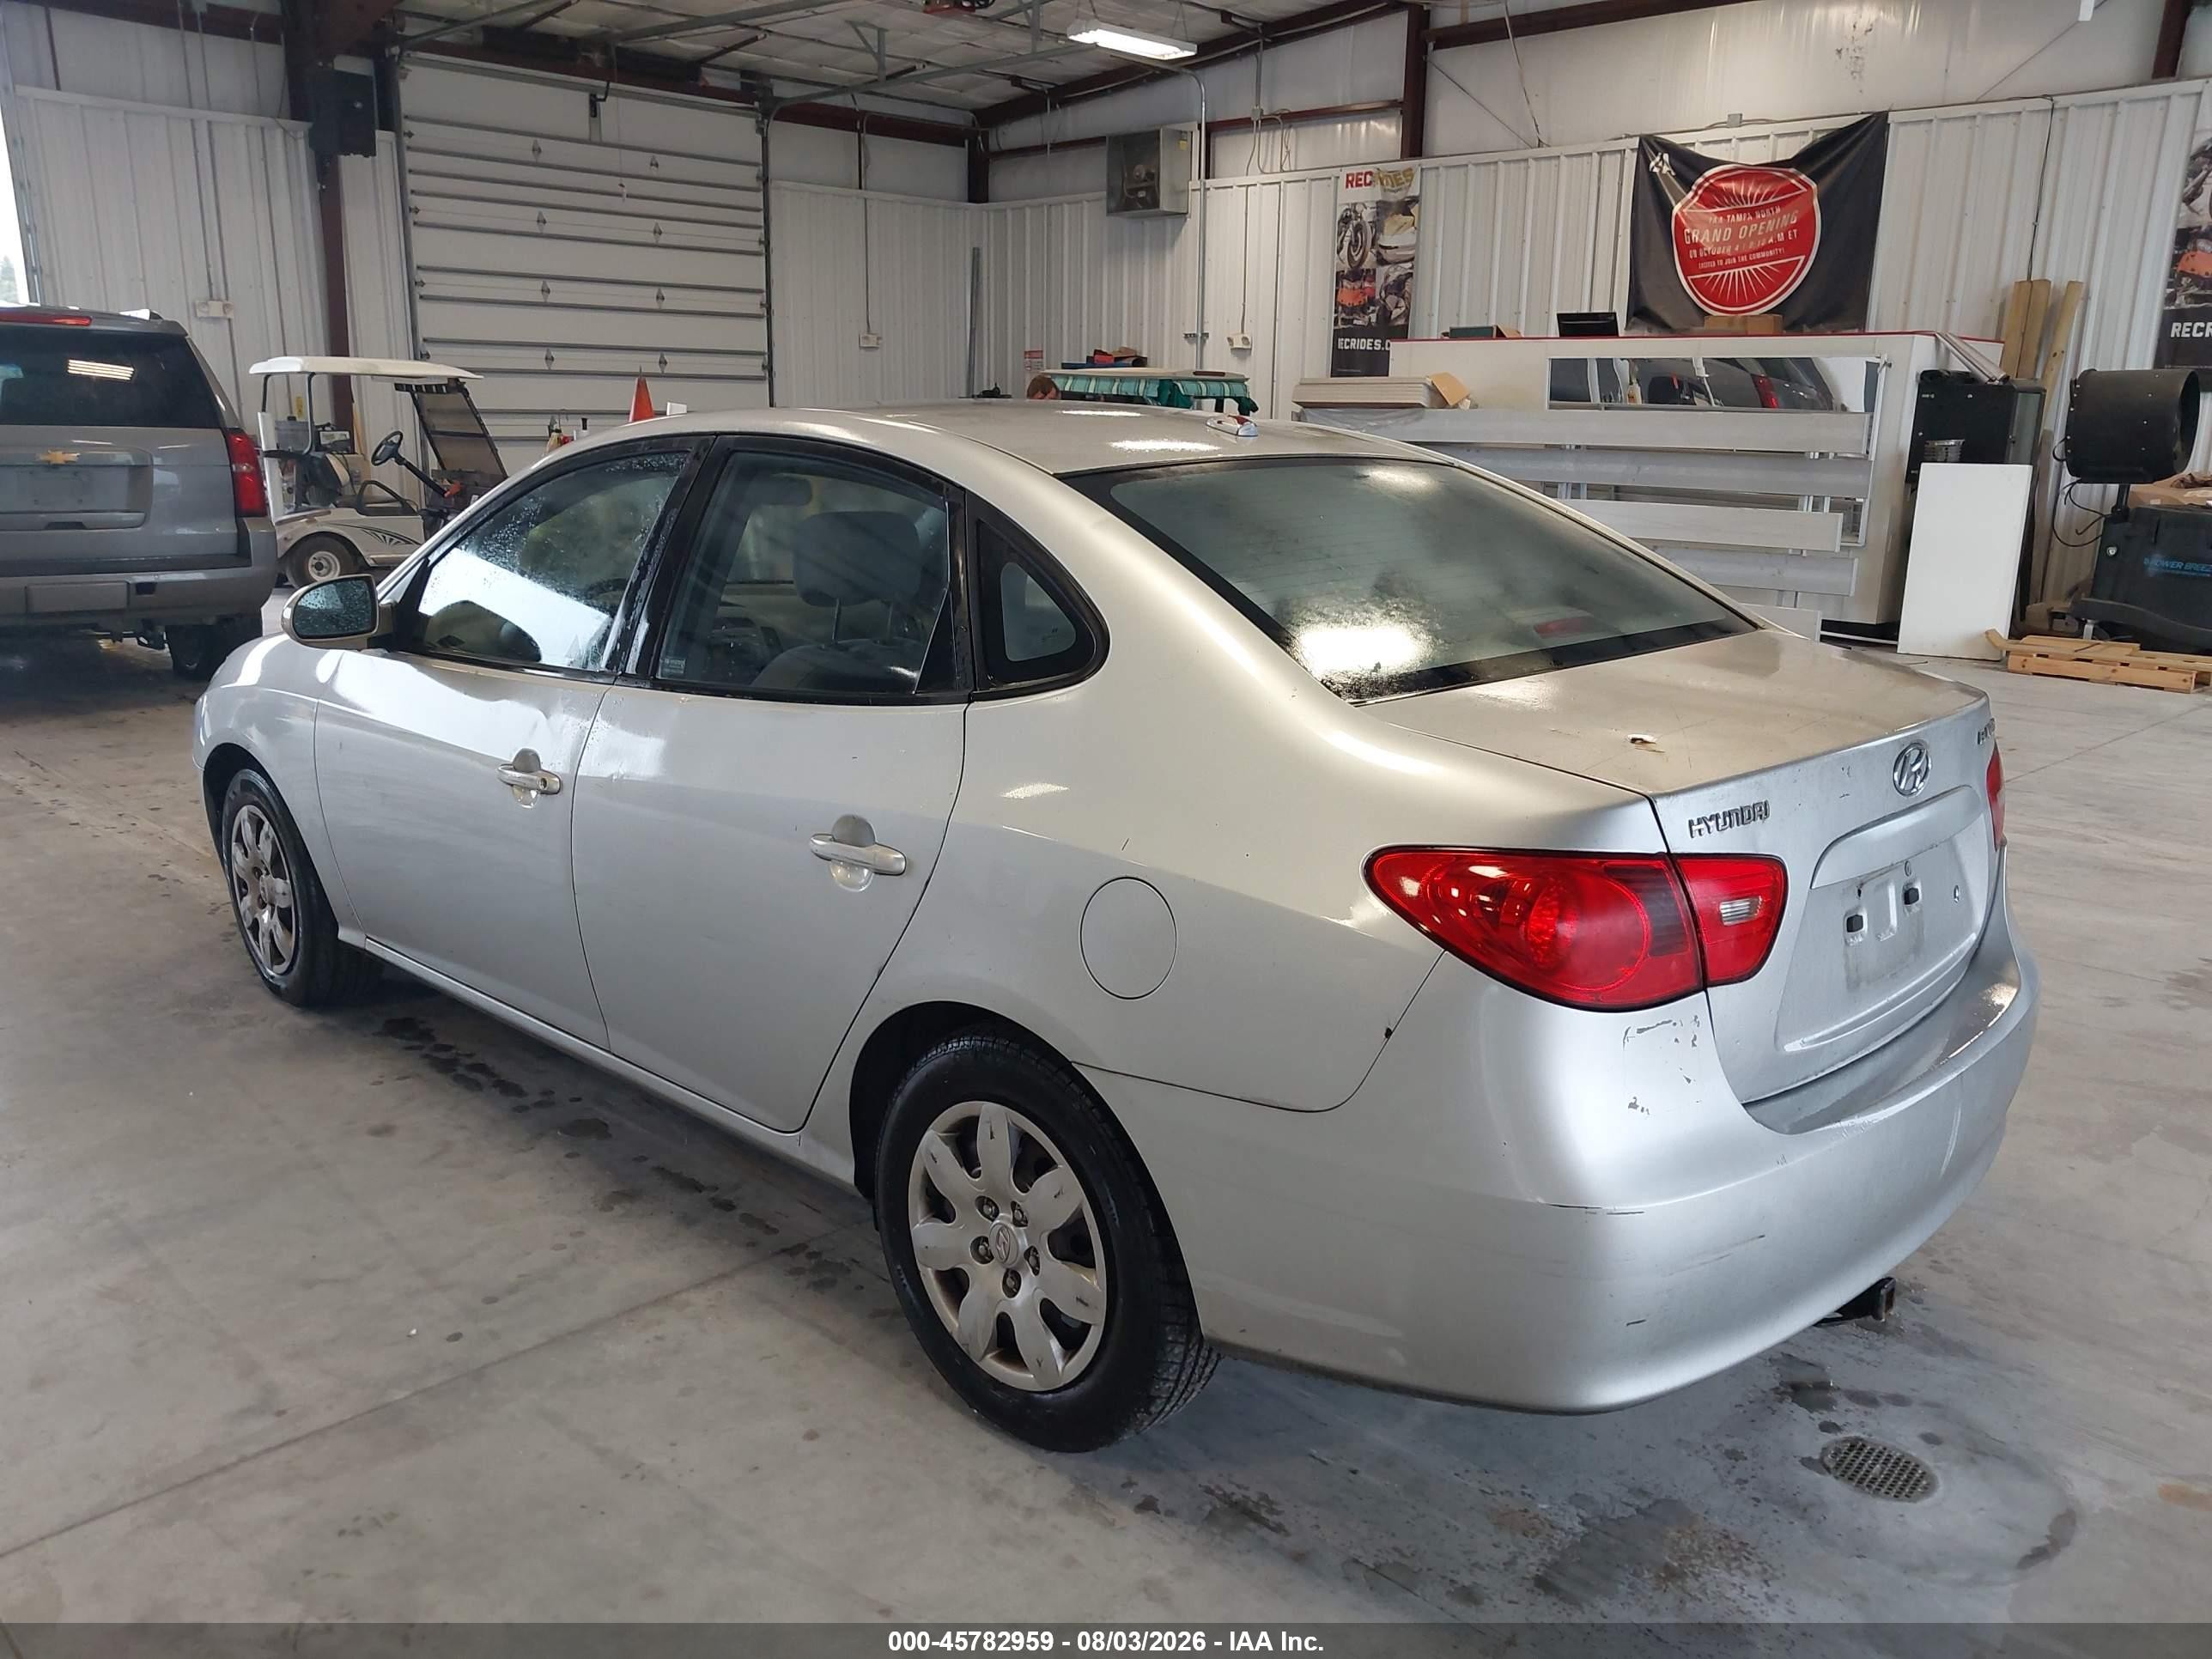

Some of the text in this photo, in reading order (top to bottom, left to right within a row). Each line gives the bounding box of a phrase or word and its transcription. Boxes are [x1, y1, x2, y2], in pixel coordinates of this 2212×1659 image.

[1727, 212, 1753, 223] TAMPA
[1755, 205, 1781, 220] NORTH
[1684, 210, 1798, 245] GRAND OPENING
[1788, 228, 1798, 240] ET
[1688, 799, 1770, 838] HYUNDAI
